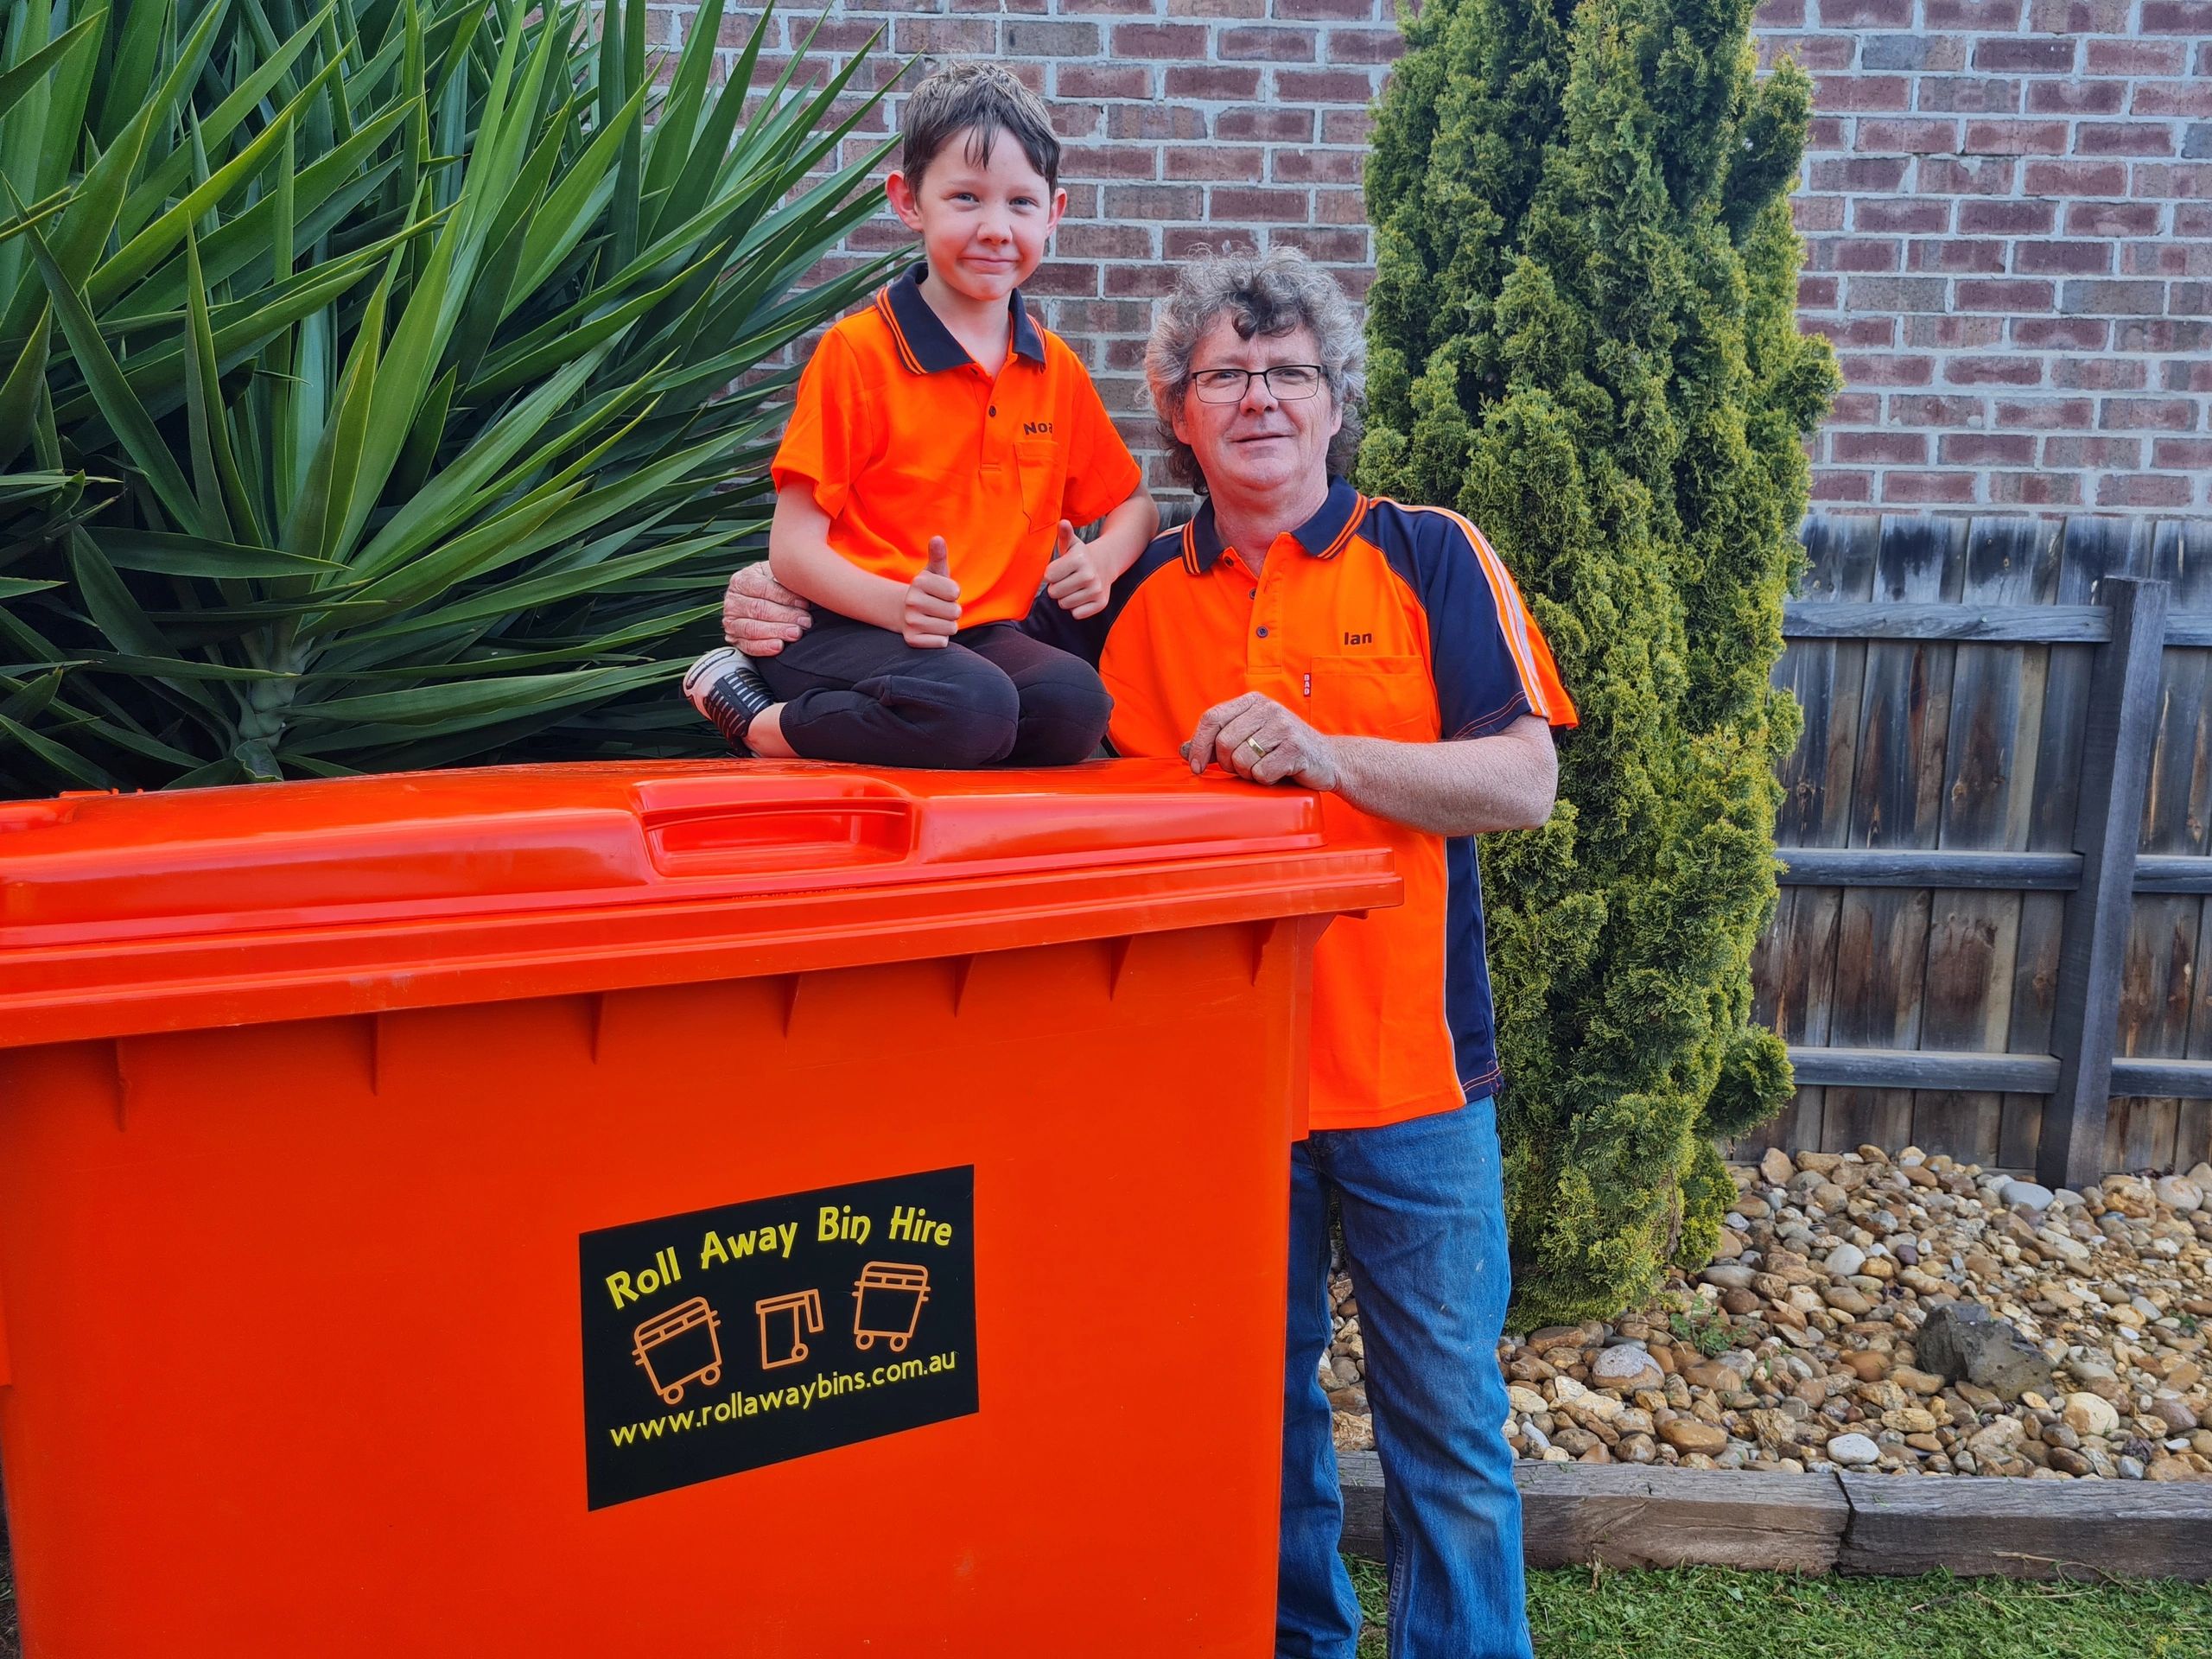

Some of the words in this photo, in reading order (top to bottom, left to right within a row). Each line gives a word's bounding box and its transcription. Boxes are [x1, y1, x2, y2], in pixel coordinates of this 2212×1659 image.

[1344, 632, 1372, 645] Ian
[605, 1247, 682, 1310] Roll
[700, 1222, 798, 1269] Away
[817, 1205, 871, 1245] Bin
[888, 1205, 953, 1246] Hire
[610, 1351, 956, 1446] www.rollawaybins.com.au
